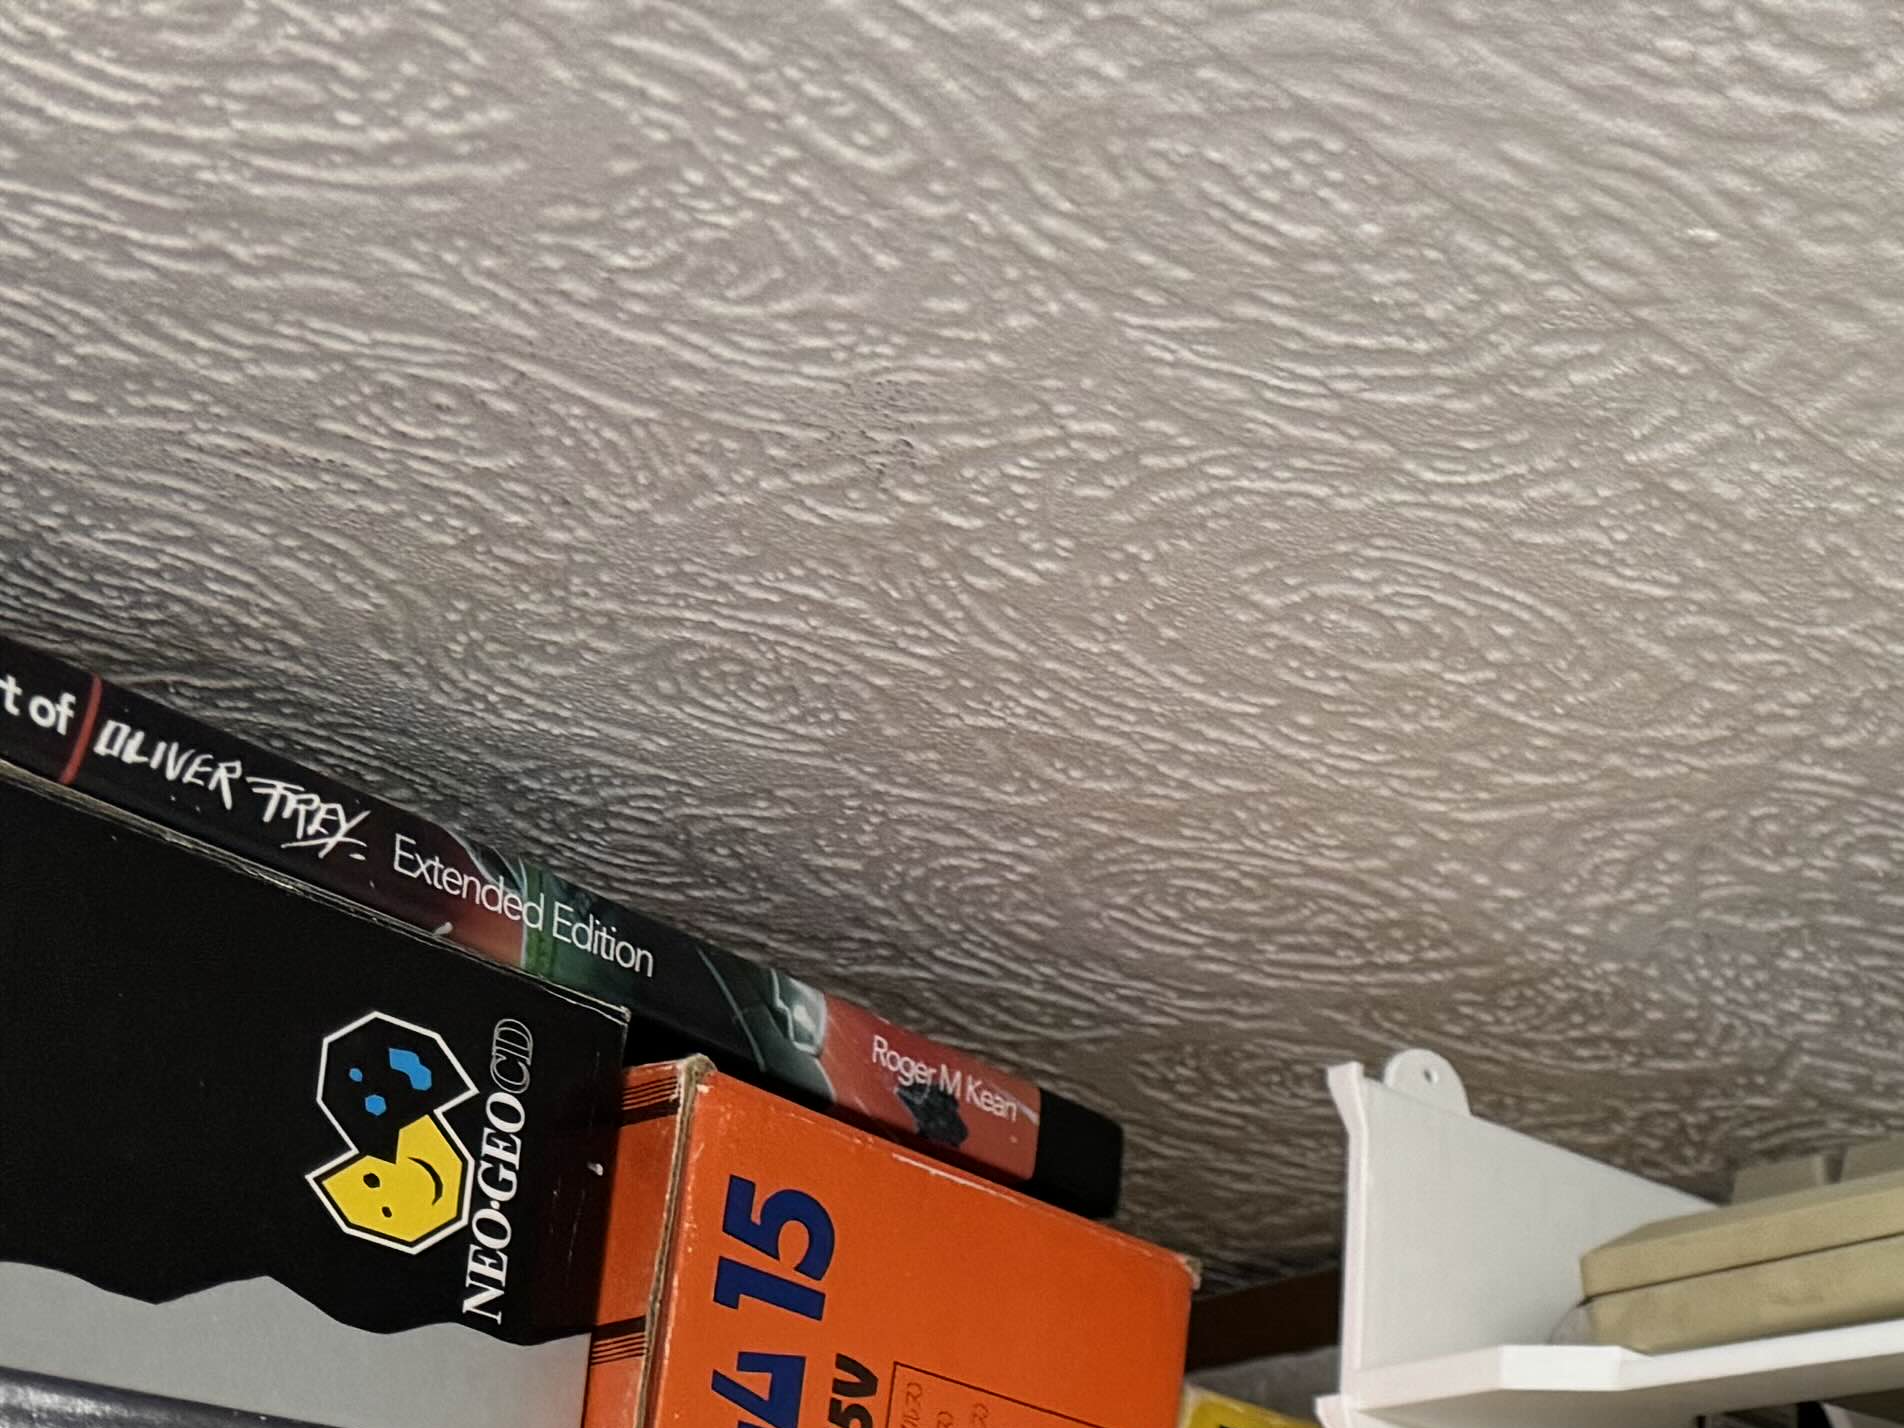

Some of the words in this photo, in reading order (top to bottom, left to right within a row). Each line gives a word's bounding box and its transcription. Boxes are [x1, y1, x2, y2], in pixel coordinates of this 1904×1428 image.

[29, 692, 76, 735] of
[94, 719, 242, 810] OLIVER
[394, 832, 544, 931] Extended
[552, 901, 654, 977] Edition
[872, 1034, 937, 1087] Roger
[940, 1064, 963, 1100] M
[966, 1075, 1017, 1124] Kean
[713, 1174, 835, 1320] 15
